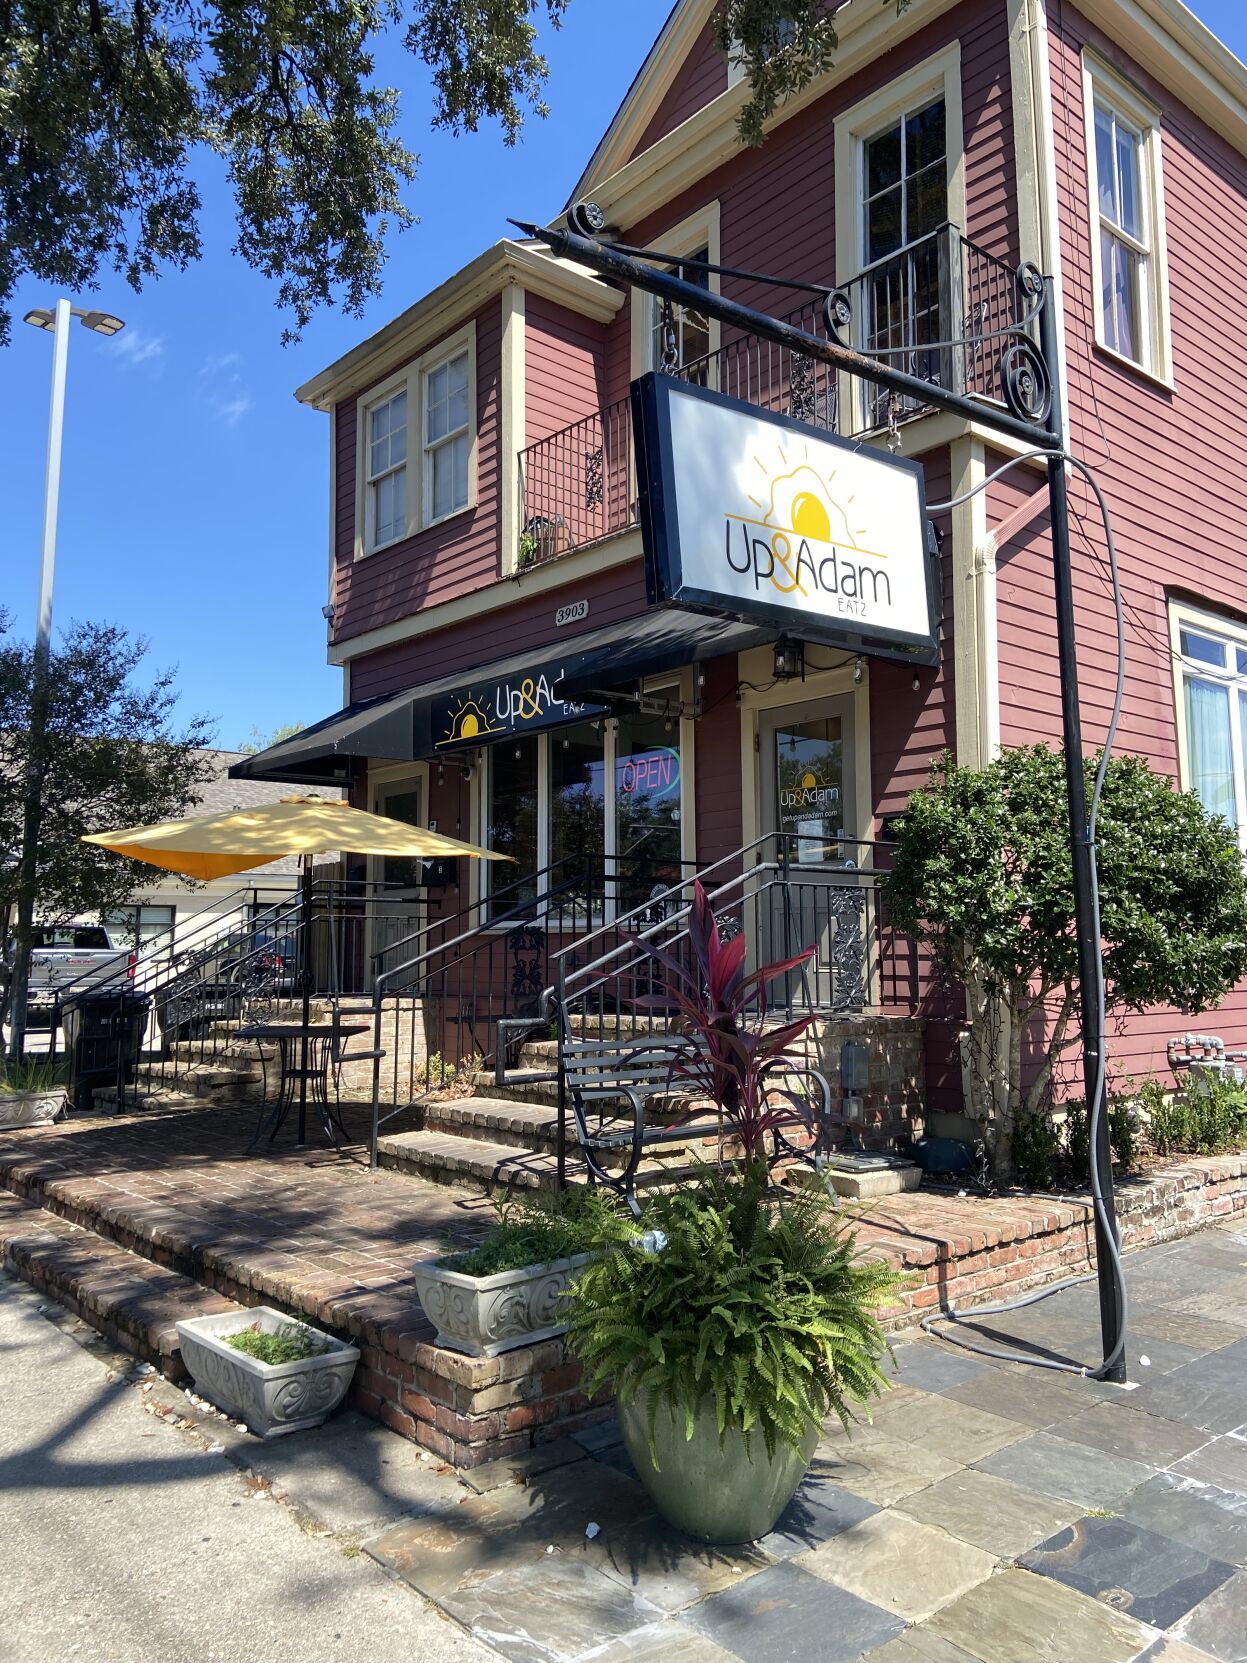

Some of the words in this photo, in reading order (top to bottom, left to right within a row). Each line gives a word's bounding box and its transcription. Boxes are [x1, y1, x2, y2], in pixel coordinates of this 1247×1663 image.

[726, 519, 892, 606] Up&Adam
[557, 602, 585, 623] 3903
[496, 668, 565, 725] Up&Ad
[623, 754, 672, 793] OPEN
[780, 786, 839, 808] Up&Adam
[782, 810, 838, 823] getupandadam.com
